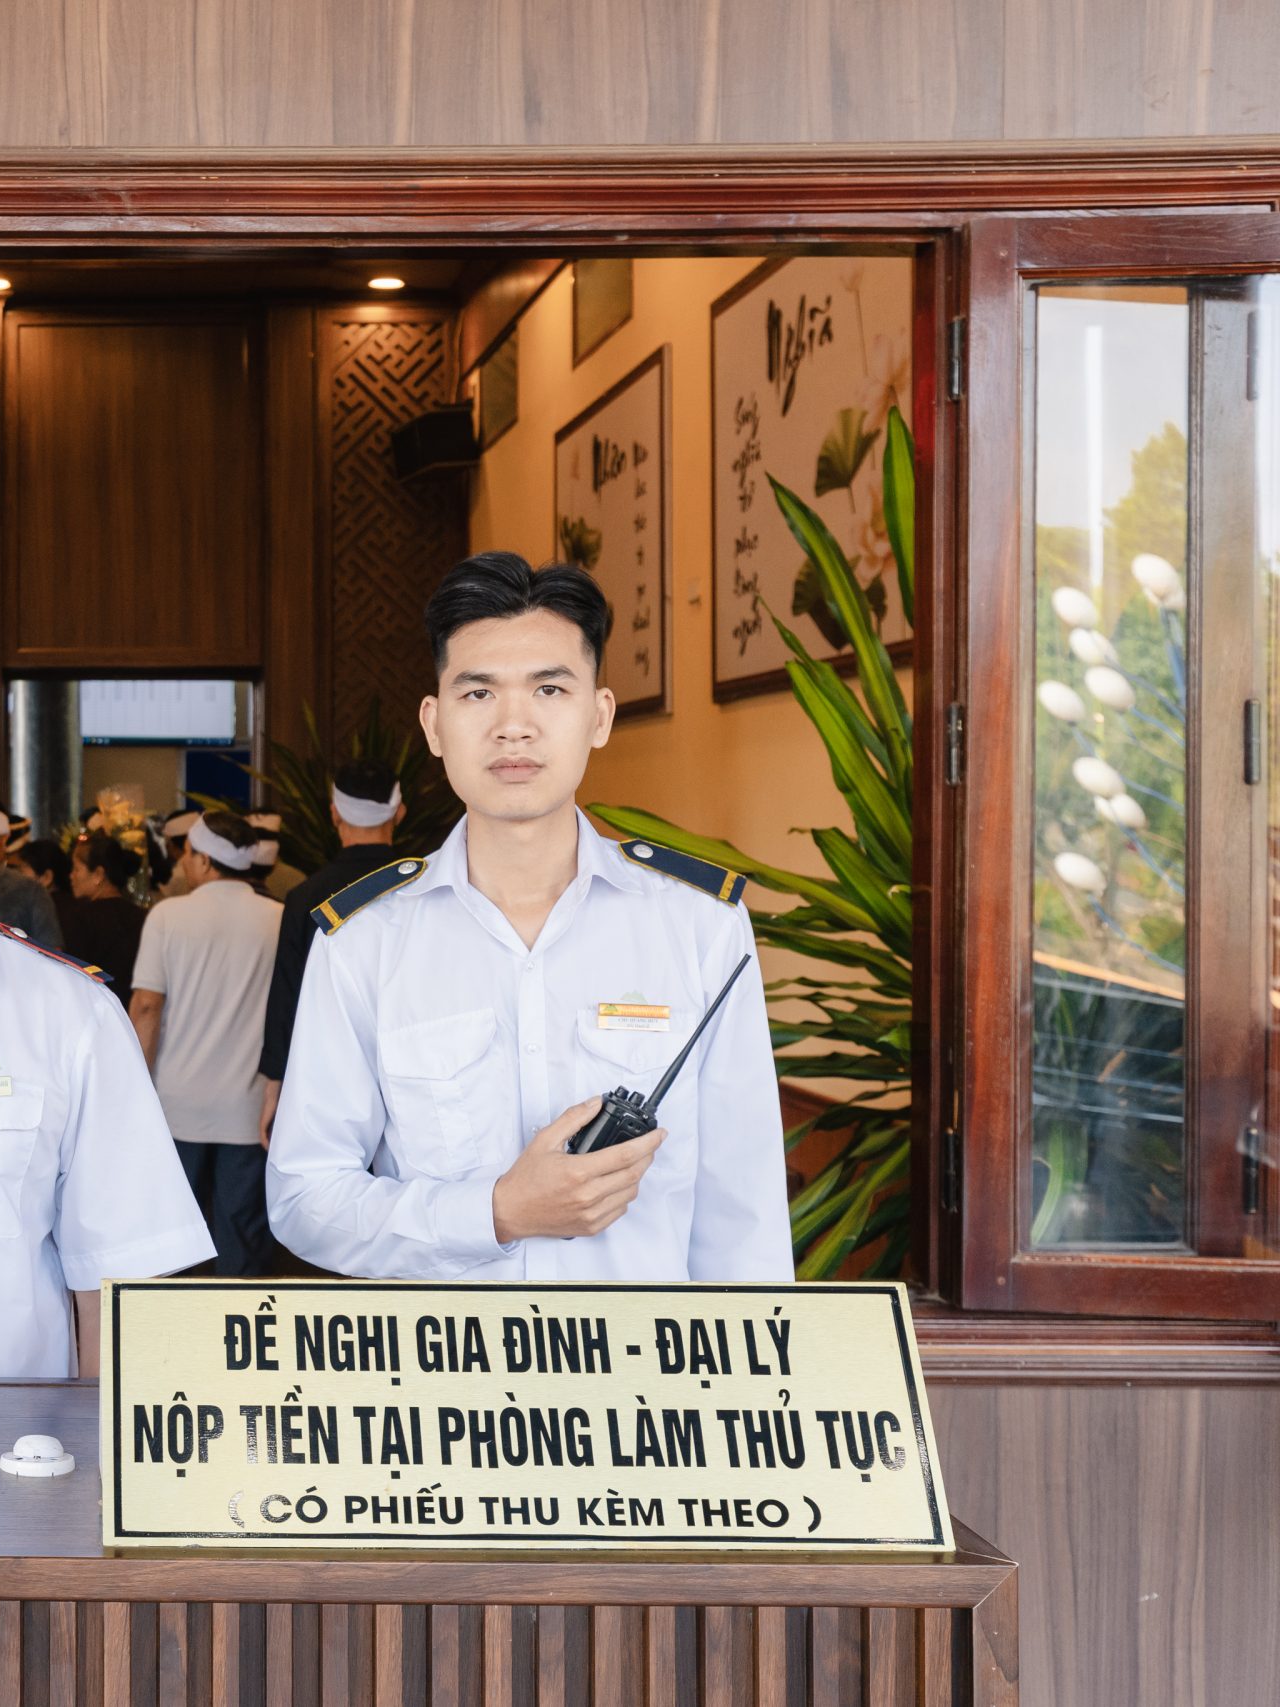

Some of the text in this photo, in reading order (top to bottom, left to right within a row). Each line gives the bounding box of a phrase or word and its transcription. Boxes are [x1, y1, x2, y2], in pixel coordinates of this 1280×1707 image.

[223, 1295, 792, 1388] ĐỀ NGHỊ GIA ĐÌNH - ĐẠI LÝ
[133, 1385, 907, 1482] NỘP TIỀN TẠI PHÒNG LÀM THỦ TỤC
[260, 1486, 328, 1524] CÓ
[344, 1483, 464, 1525] PHIẾU
[478, 1496, 560, 1525] THU
[577, 1488, 665, 1526] KÈM
[678, 1498, 789, 1528] THEO
